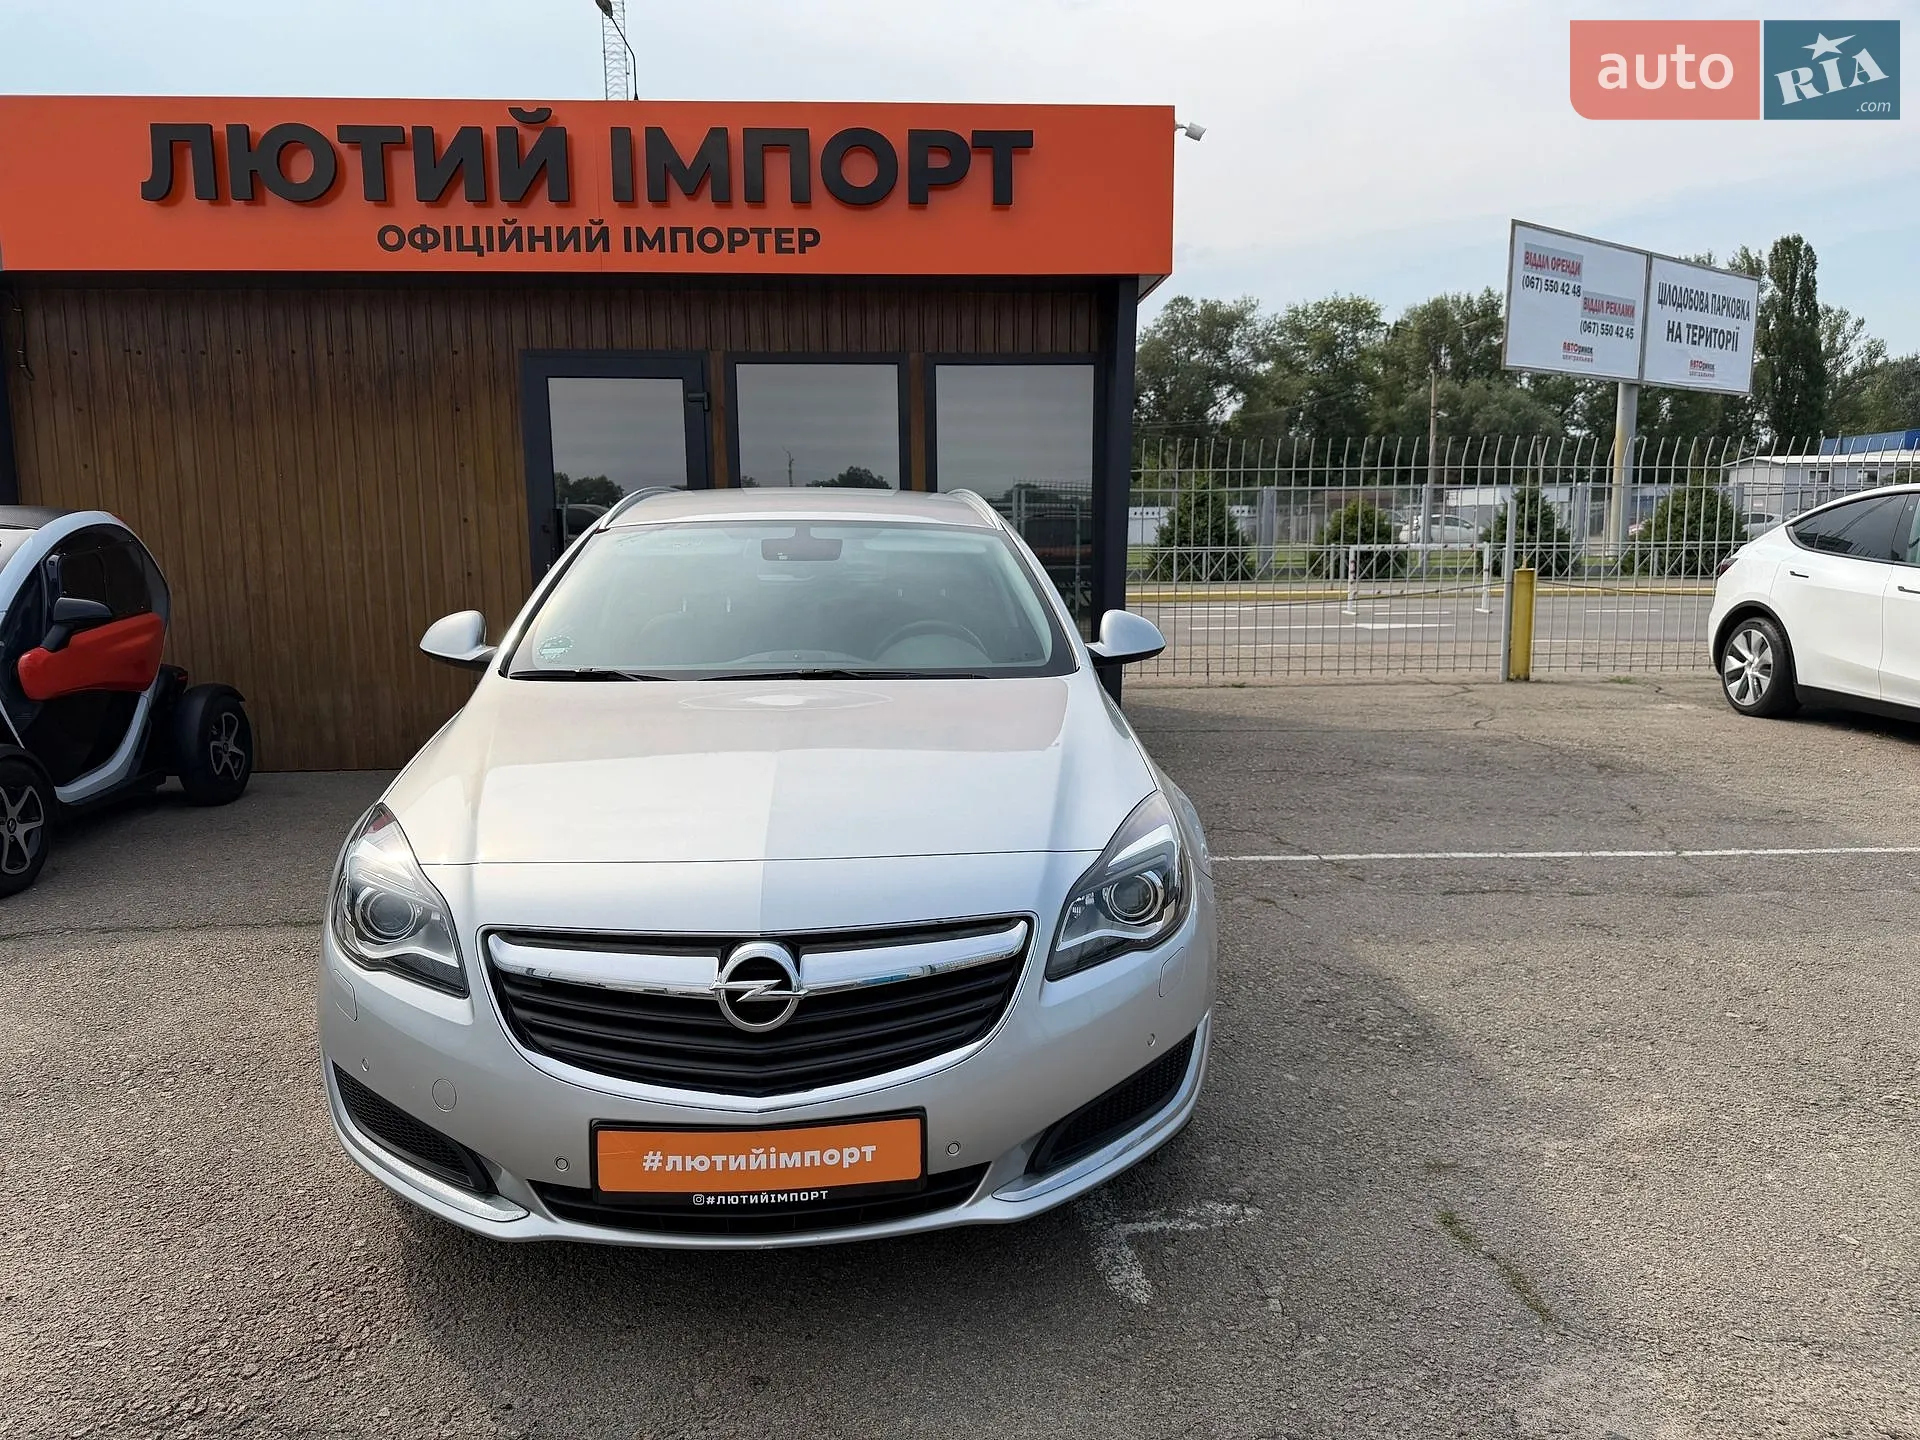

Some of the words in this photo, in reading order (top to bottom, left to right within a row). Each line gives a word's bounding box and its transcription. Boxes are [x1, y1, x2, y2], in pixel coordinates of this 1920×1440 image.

[140, 107, 571, 203] ЛЮТИЙ
[612, 127, 1034, 206] ІМПОРТ
[377, 219, 610, 257] ОФІЦІЙНИЙ
[624, 226, 821, 255] ІМПОРТЕР
[1525, 252, 1550, 270] ВІДДІЛ
[1551, 257, 1581, 276] ОРЕНДИ
[1522, 275, 1543, 293] (067)
[1544, 279, 1559, 293] 550
[1560, 282, 1570, 295] 42
[1571, 284, 1581, 297] 48
[1605, 301, 1635, 318] РЕКЛАМИ
[1658, 282, 1709, 313] ЦІЛОДОБОВА
[1710, 294, 1750, 322] ПАРКОВКА
[1580, 320, 1599, 336] (067)
[1600, 323, 1614, 336] 550
[1615, 325, 1624, 338] 42
[1625, 327, 1634, 340] 45
[1666, 320, 1682, 344] НА
[1685, 323, 1740, 352] ТЕРИТОРІЇ
[643, 1145, 877, 1172] #лютийімпорт
